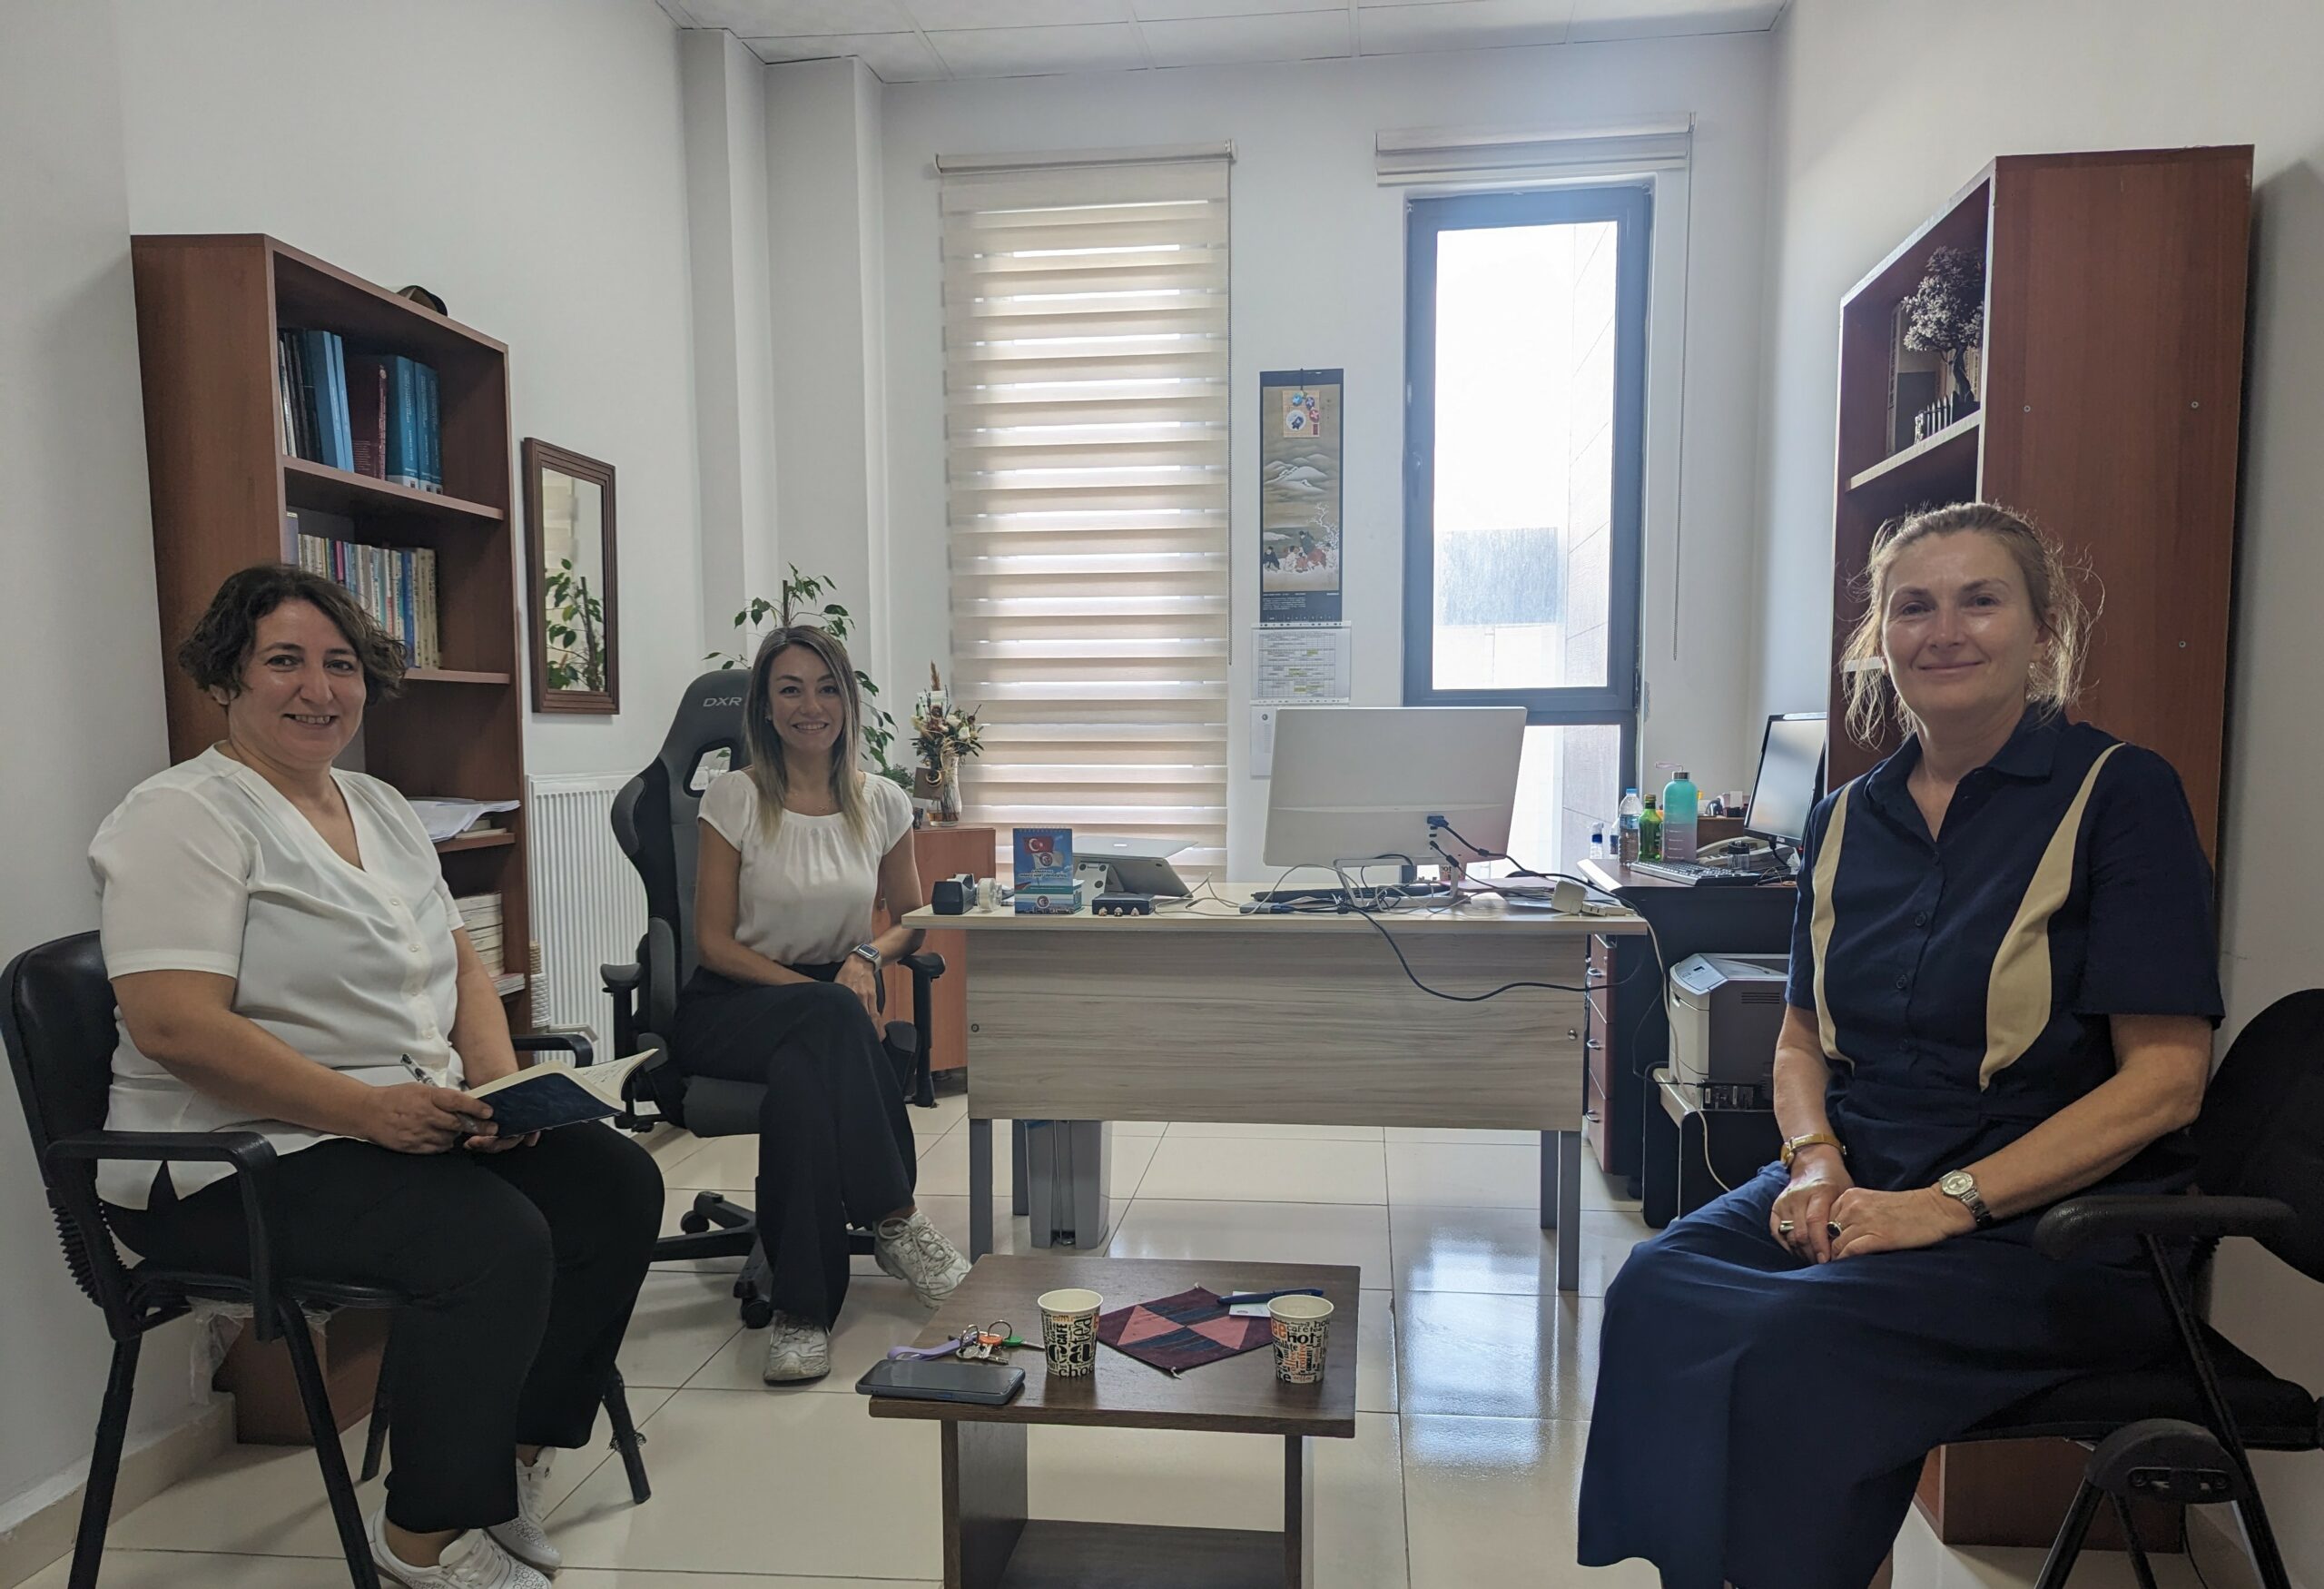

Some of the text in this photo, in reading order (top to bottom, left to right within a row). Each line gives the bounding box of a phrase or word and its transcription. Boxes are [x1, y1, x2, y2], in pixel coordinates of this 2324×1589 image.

[703, 696, 743, 707] DXR
[1057, 1323, 1068, 1345] CAFE
[1070, 1316, 1092, 1344] tea
[1287, 1331, 1316, 1344] hot
